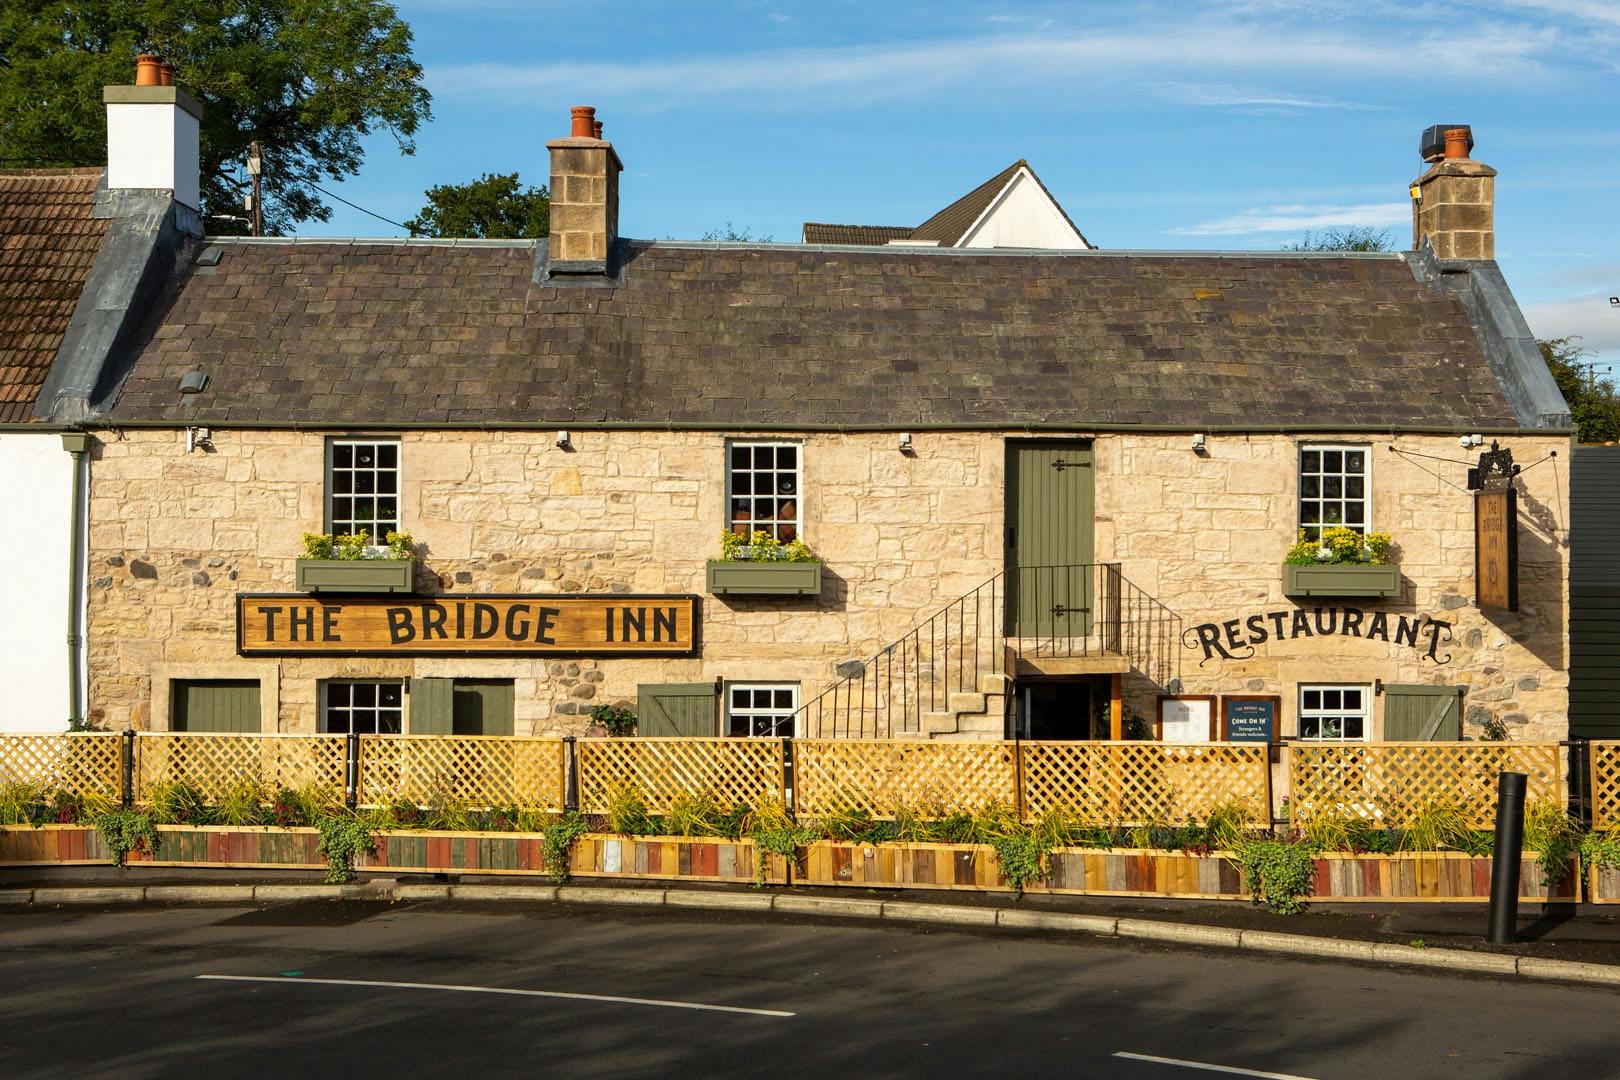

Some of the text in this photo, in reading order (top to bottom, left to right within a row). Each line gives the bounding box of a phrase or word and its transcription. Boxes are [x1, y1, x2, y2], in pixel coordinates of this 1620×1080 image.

[257, 602, 678, 646] THE BRIDGE INN
[1182, 607, 1452, 667] RESTAURANT
